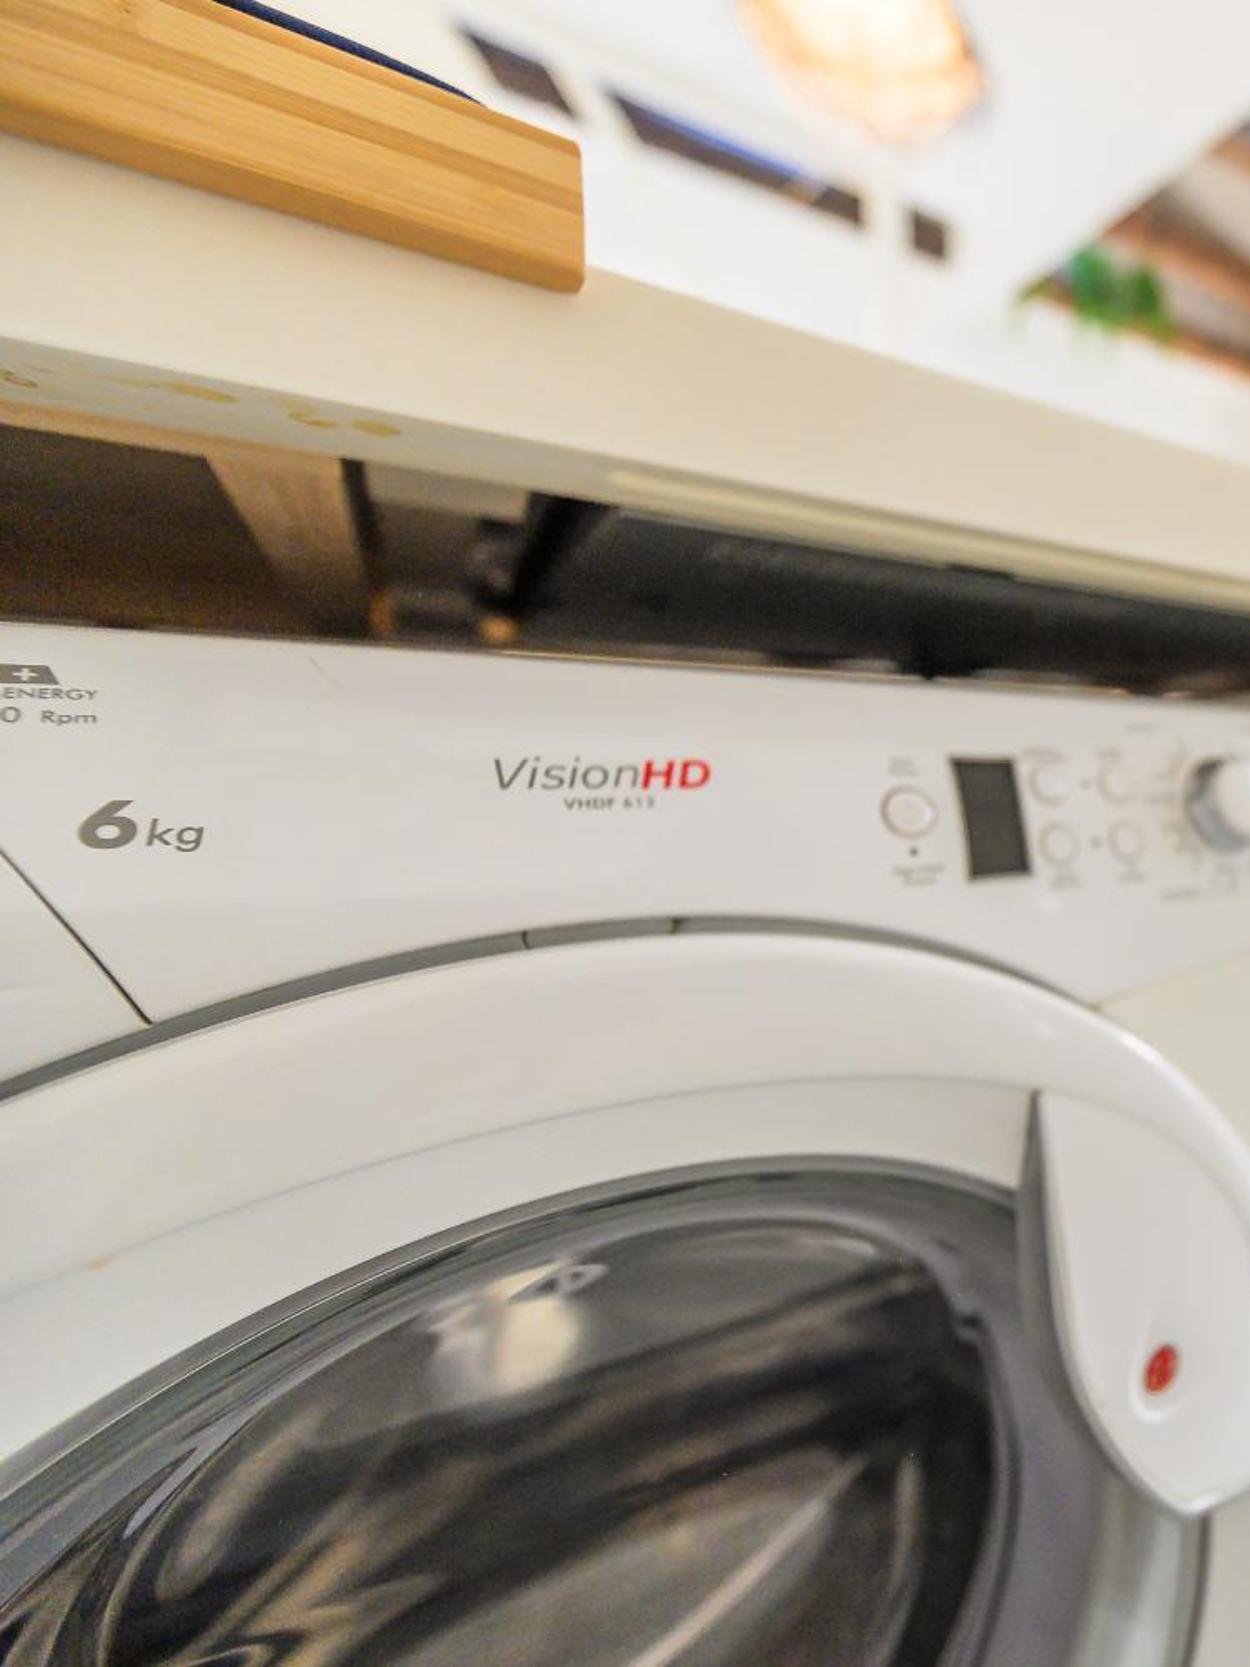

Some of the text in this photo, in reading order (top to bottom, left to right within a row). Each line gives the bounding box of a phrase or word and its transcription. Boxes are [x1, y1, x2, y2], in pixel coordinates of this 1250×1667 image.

[3, 687, 98, 700] ENERGY
[40, 710, 98, 726] Rpm
[494, 756, 711, 791] VisionHD
[563, 797, 614, 810] VHDF
[78, 800, 204, 852] 6 kg
